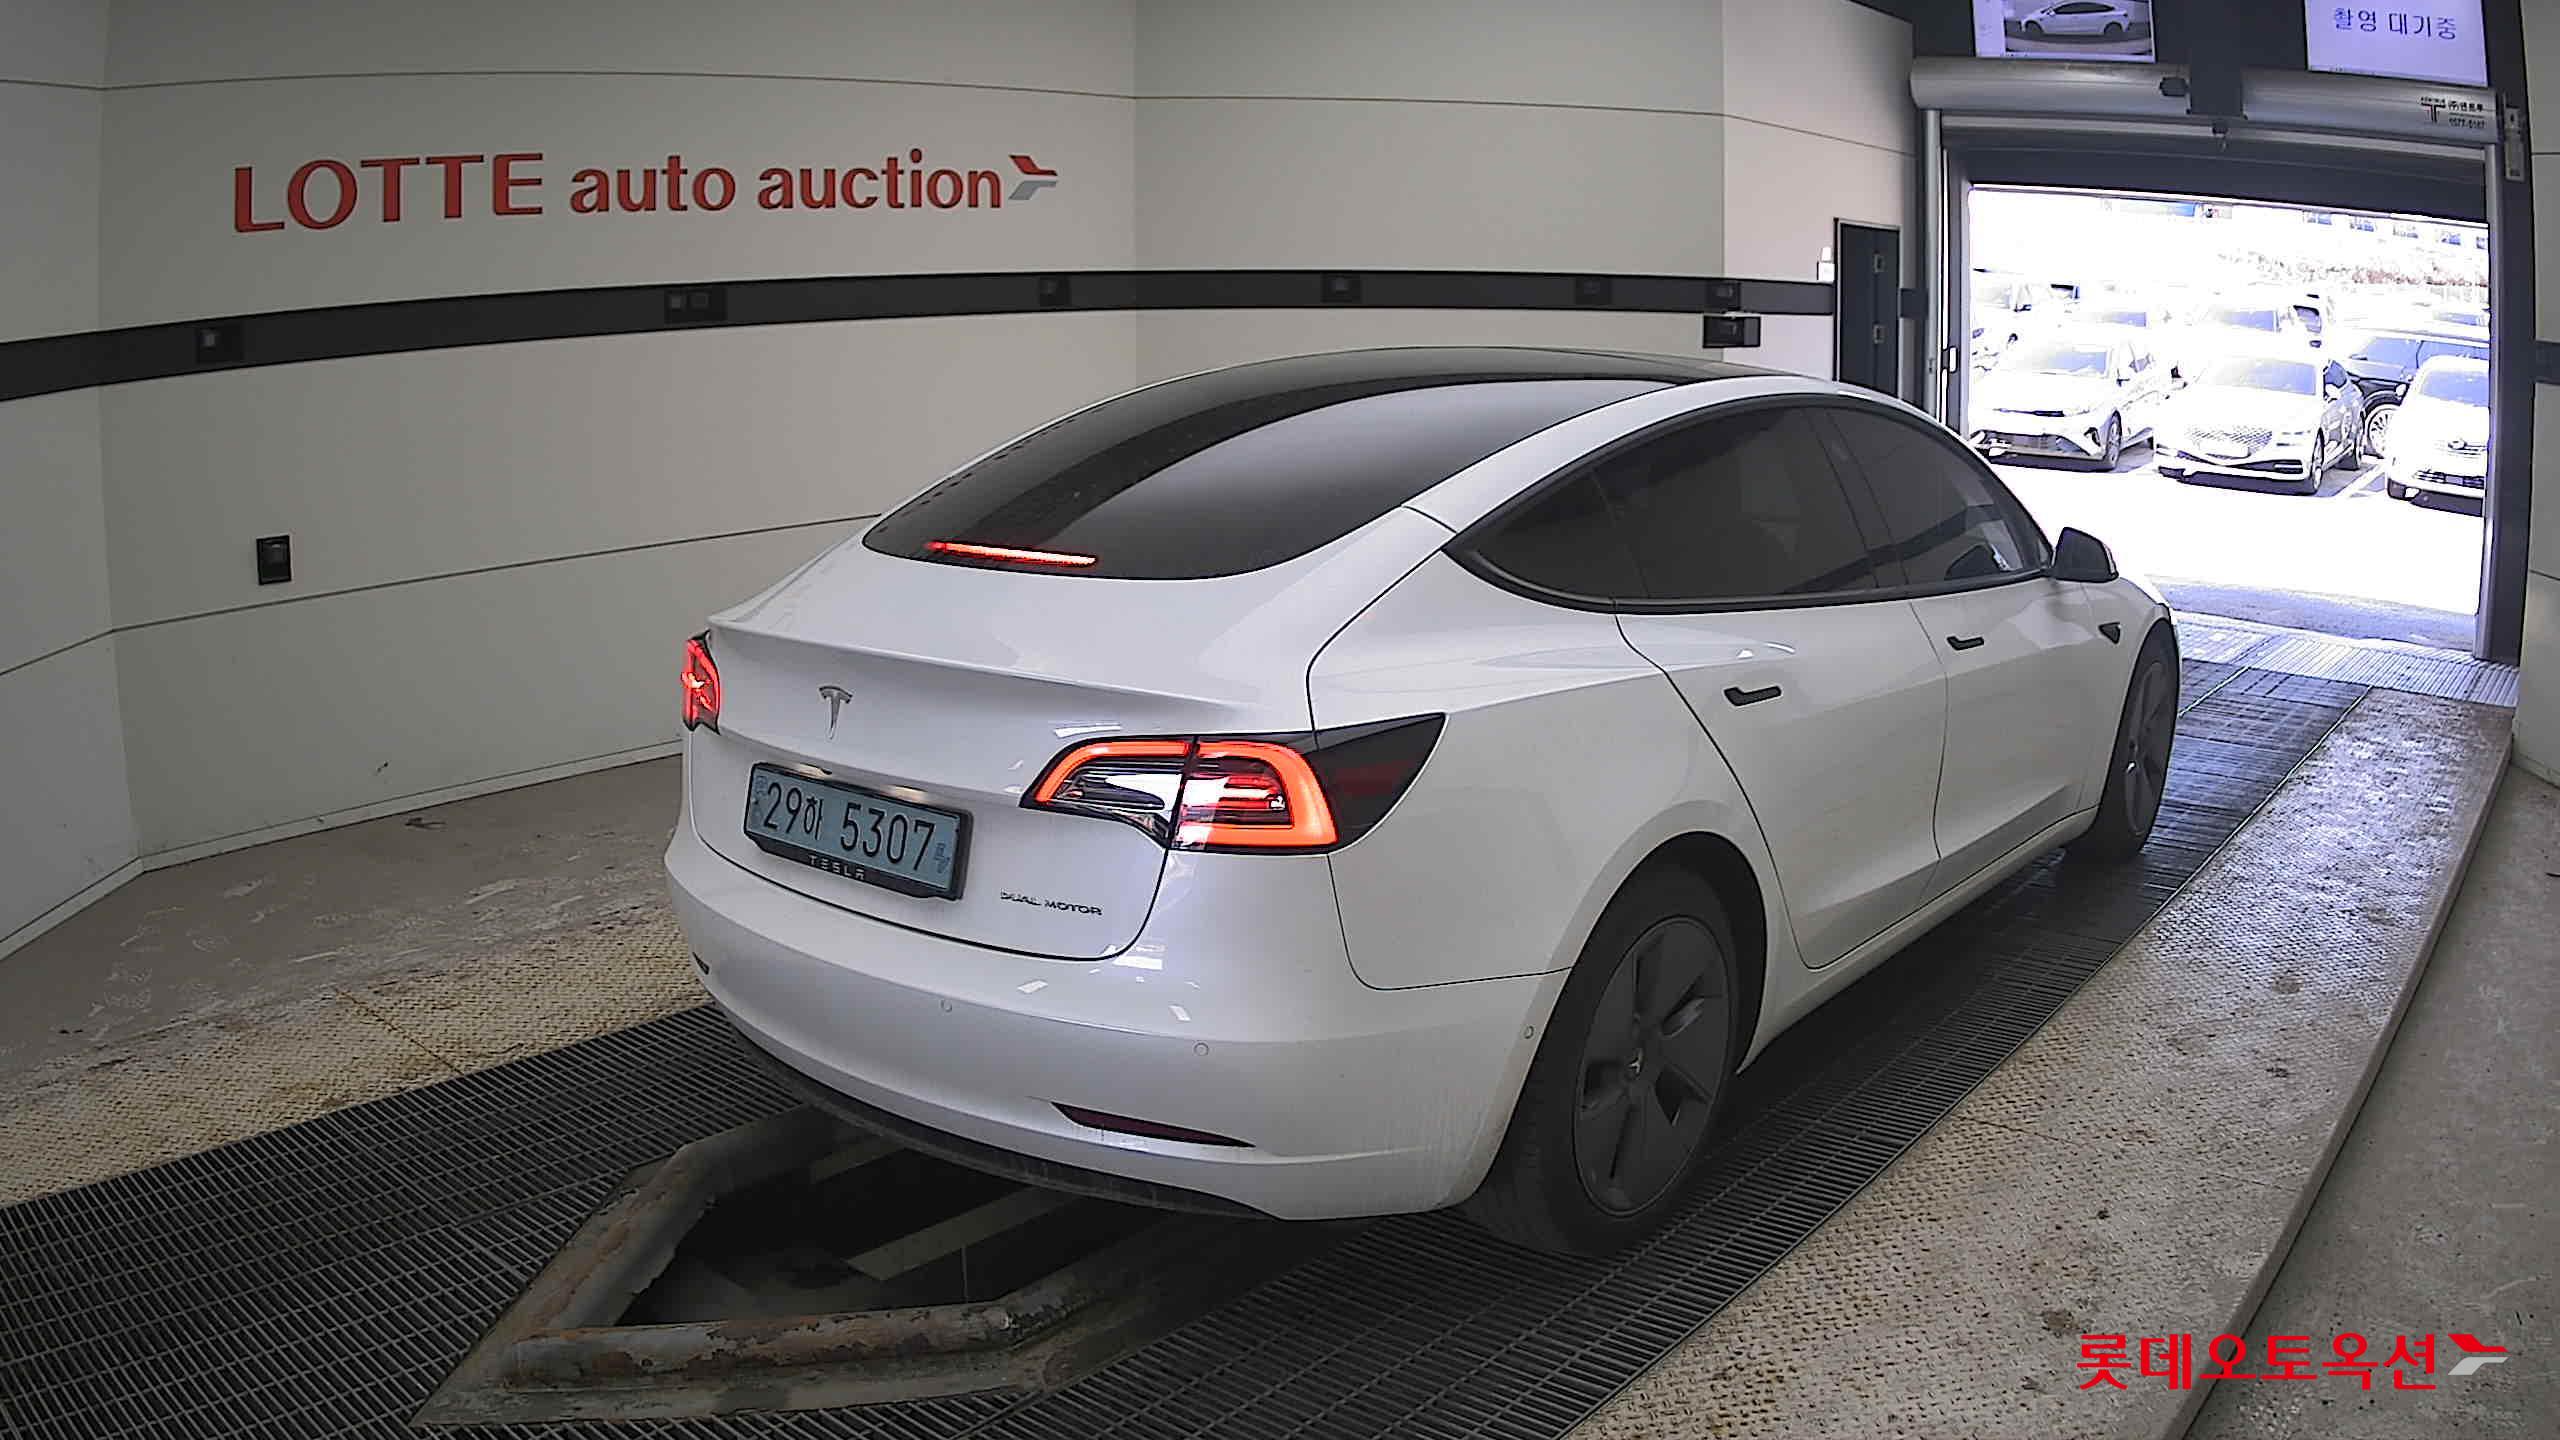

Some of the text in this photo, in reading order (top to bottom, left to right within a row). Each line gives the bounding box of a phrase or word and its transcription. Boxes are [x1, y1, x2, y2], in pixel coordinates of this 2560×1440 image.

[2388, 12, 2457, 40] 대기중
[234, 148, 1001, 233] LOTTE auto auction
[763, 782, 935, 871] 29하 5307
[808, 854, 866, 881] TESLA
[1000, 891, 1103, 916] DUAL MOTOR
